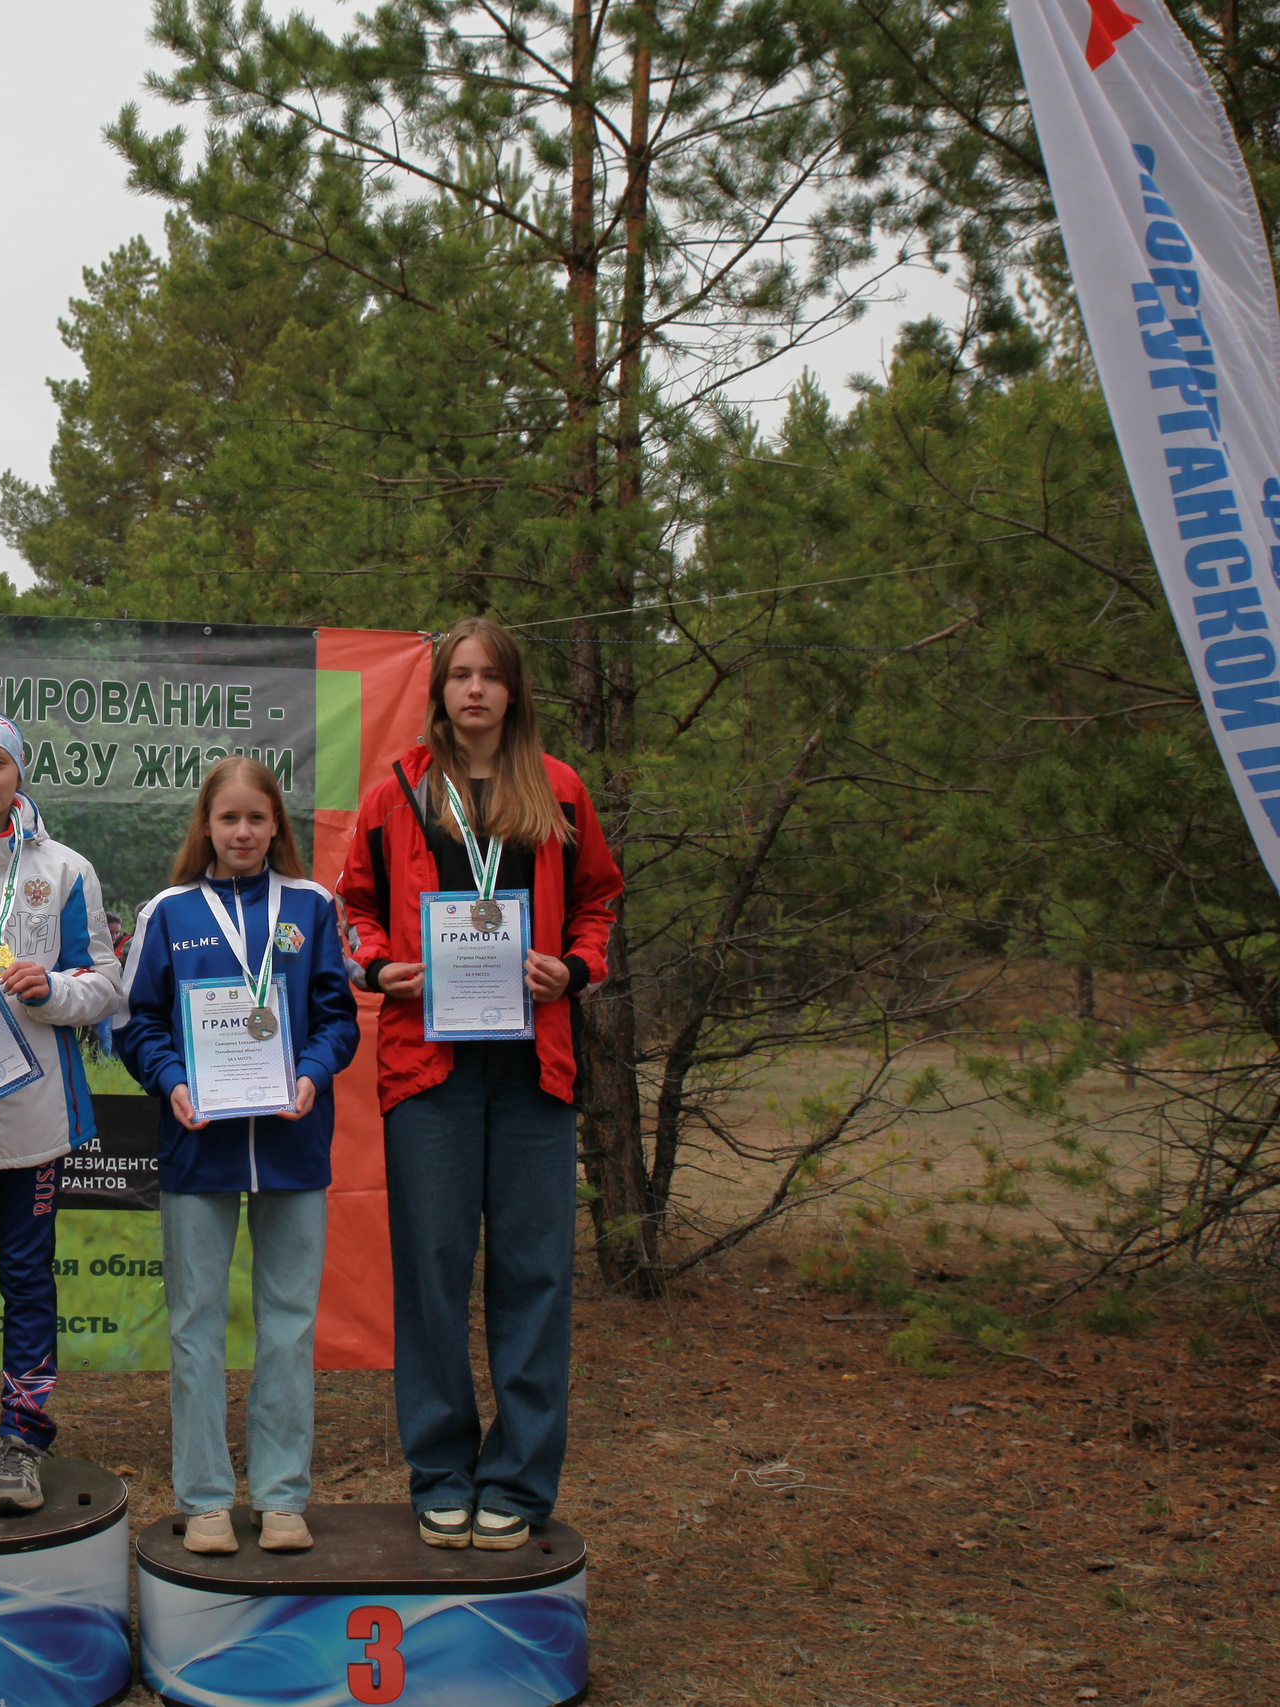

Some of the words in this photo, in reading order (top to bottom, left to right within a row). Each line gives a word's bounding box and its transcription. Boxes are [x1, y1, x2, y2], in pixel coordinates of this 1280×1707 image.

[172, 937, 219, 951] KELME
[440, 932, 510, 942] ГРАМОТА
[61, 1176, 127, 1190] РАНТОВ
[347, 1606, 405, 1705] 3
